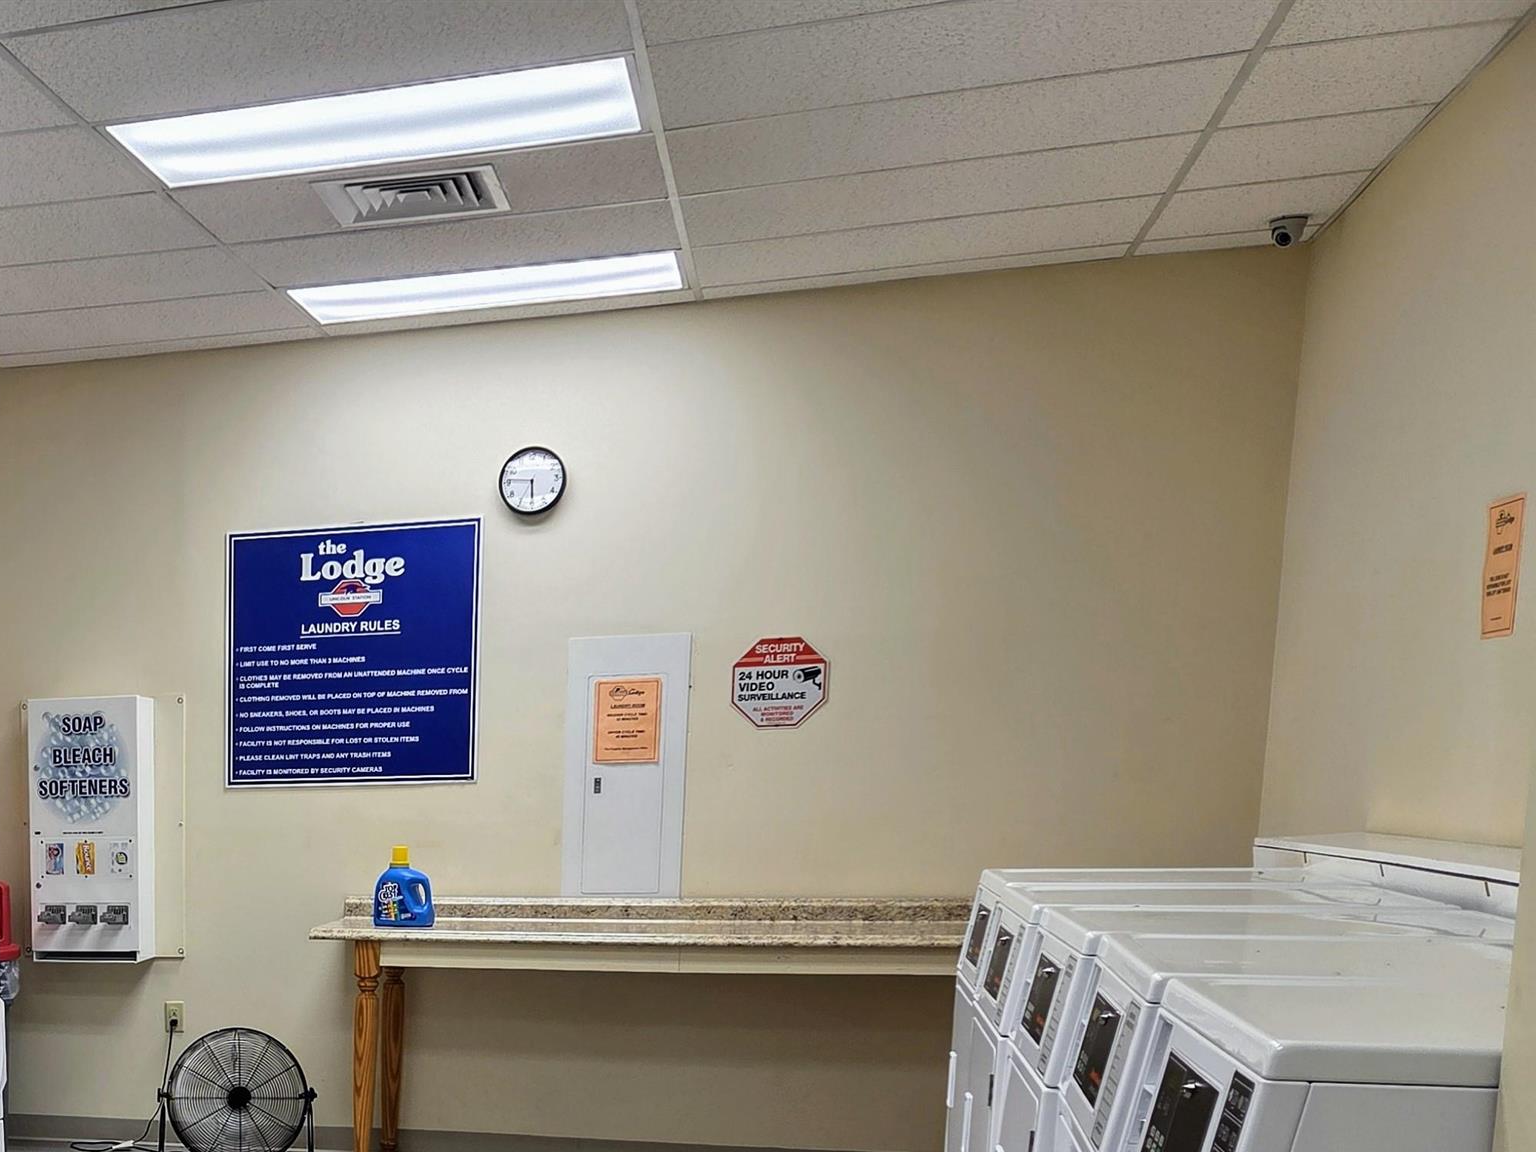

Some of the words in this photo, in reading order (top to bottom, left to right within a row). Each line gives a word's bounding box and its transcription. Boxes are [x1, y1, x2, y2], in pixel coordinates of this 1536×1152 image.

[318, 539, 347, 555] the
[300, 549, 405, 584] Lodge
[301, 621, 357, 634] LAUNDRY
[360, 619, 400, 631] RULES
[296, 643, 317, 651] SERVE
[755, 642, 805, 653] SECURITY
[333, 656, 365, 664] MACHINES
[764, 653, 796, 663] ALERT
[397, 668, 426, 676] MACHINE
[738, 672, 752, 681] 24
[756, 670, 789, 680] HOUR
[738, 682, 775, 692] VIDEO
[738, 692, 807, 701] SURVEILLANCE
[61, 716, 105, 733] SOAP
[266, 724, 310, 732] INSTRUCTIONS
[52, 748, 114, 765] BLEACH
[39, 778, 129, 797] SOFTENERS
